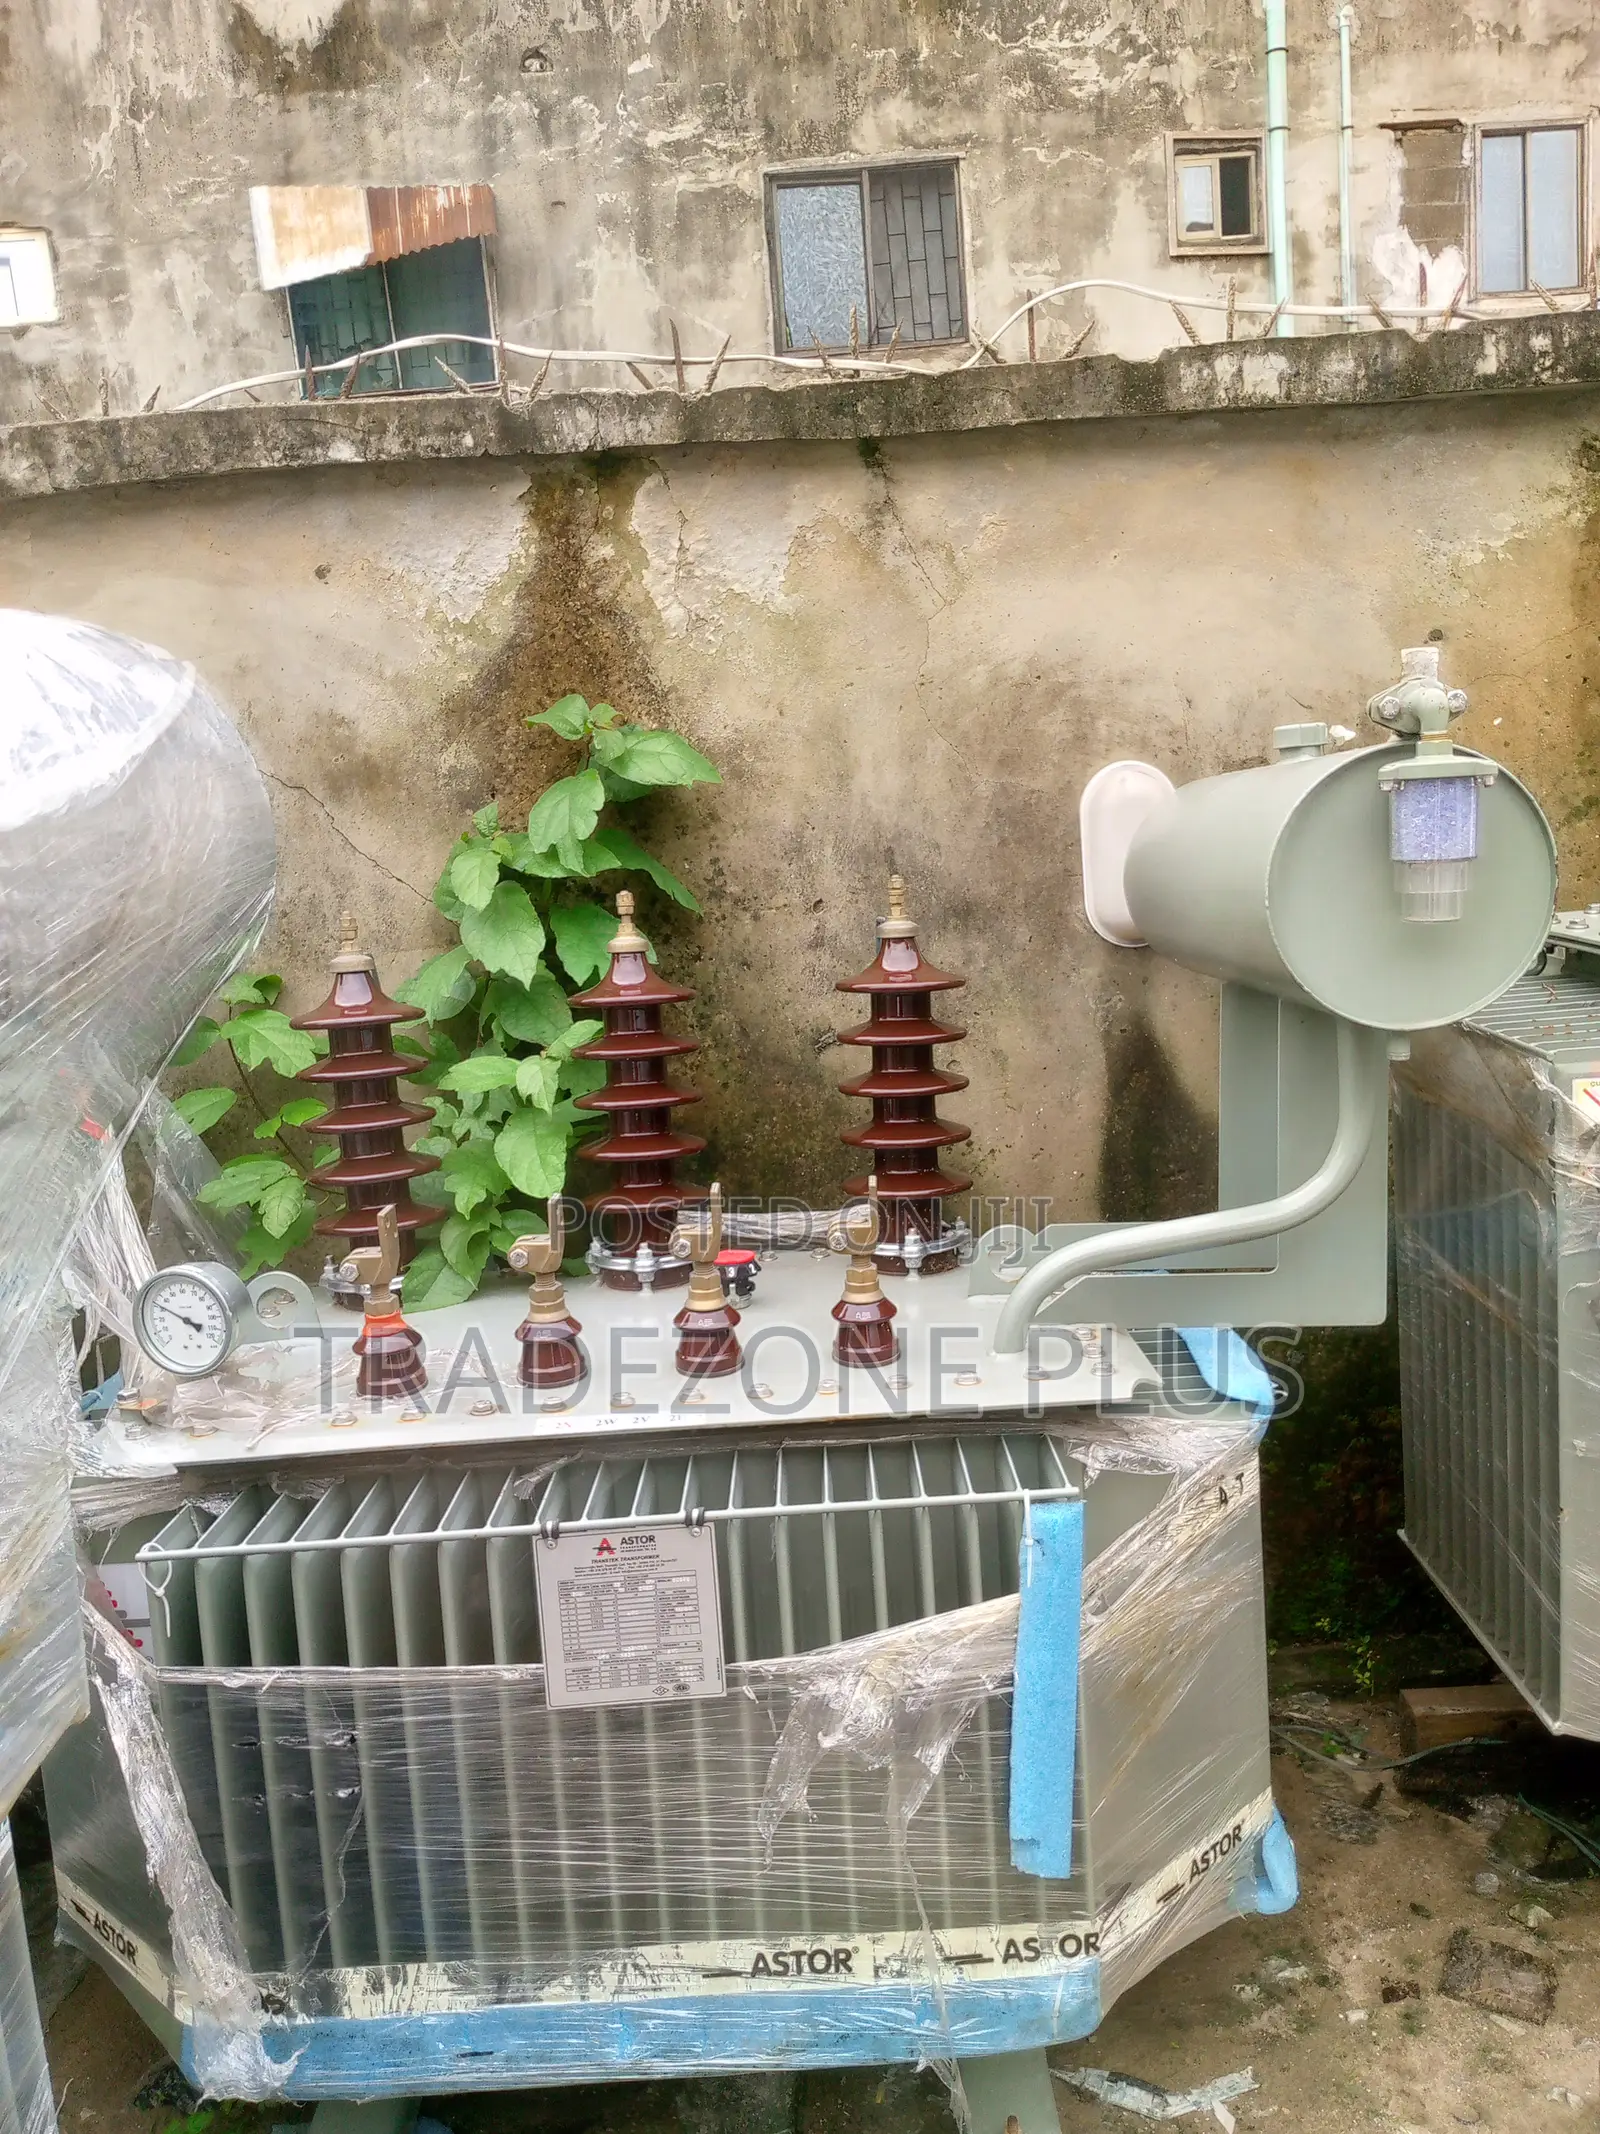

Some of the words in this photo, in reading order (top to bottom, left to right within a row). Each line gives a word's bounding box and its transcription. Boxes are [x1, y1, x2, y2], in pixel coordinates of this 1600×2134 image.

[728, 1266, 735, 1277] 3
[620, 1535, 656, 1546] ASTOR
[1189, 1824, 1243, 1884] ASTOR
[94, 1912, 137, 1966] ASTOR
[1002, 1932, 1101, 1965] ASOR
[751, 1947, 854, 1977] ASTOR
